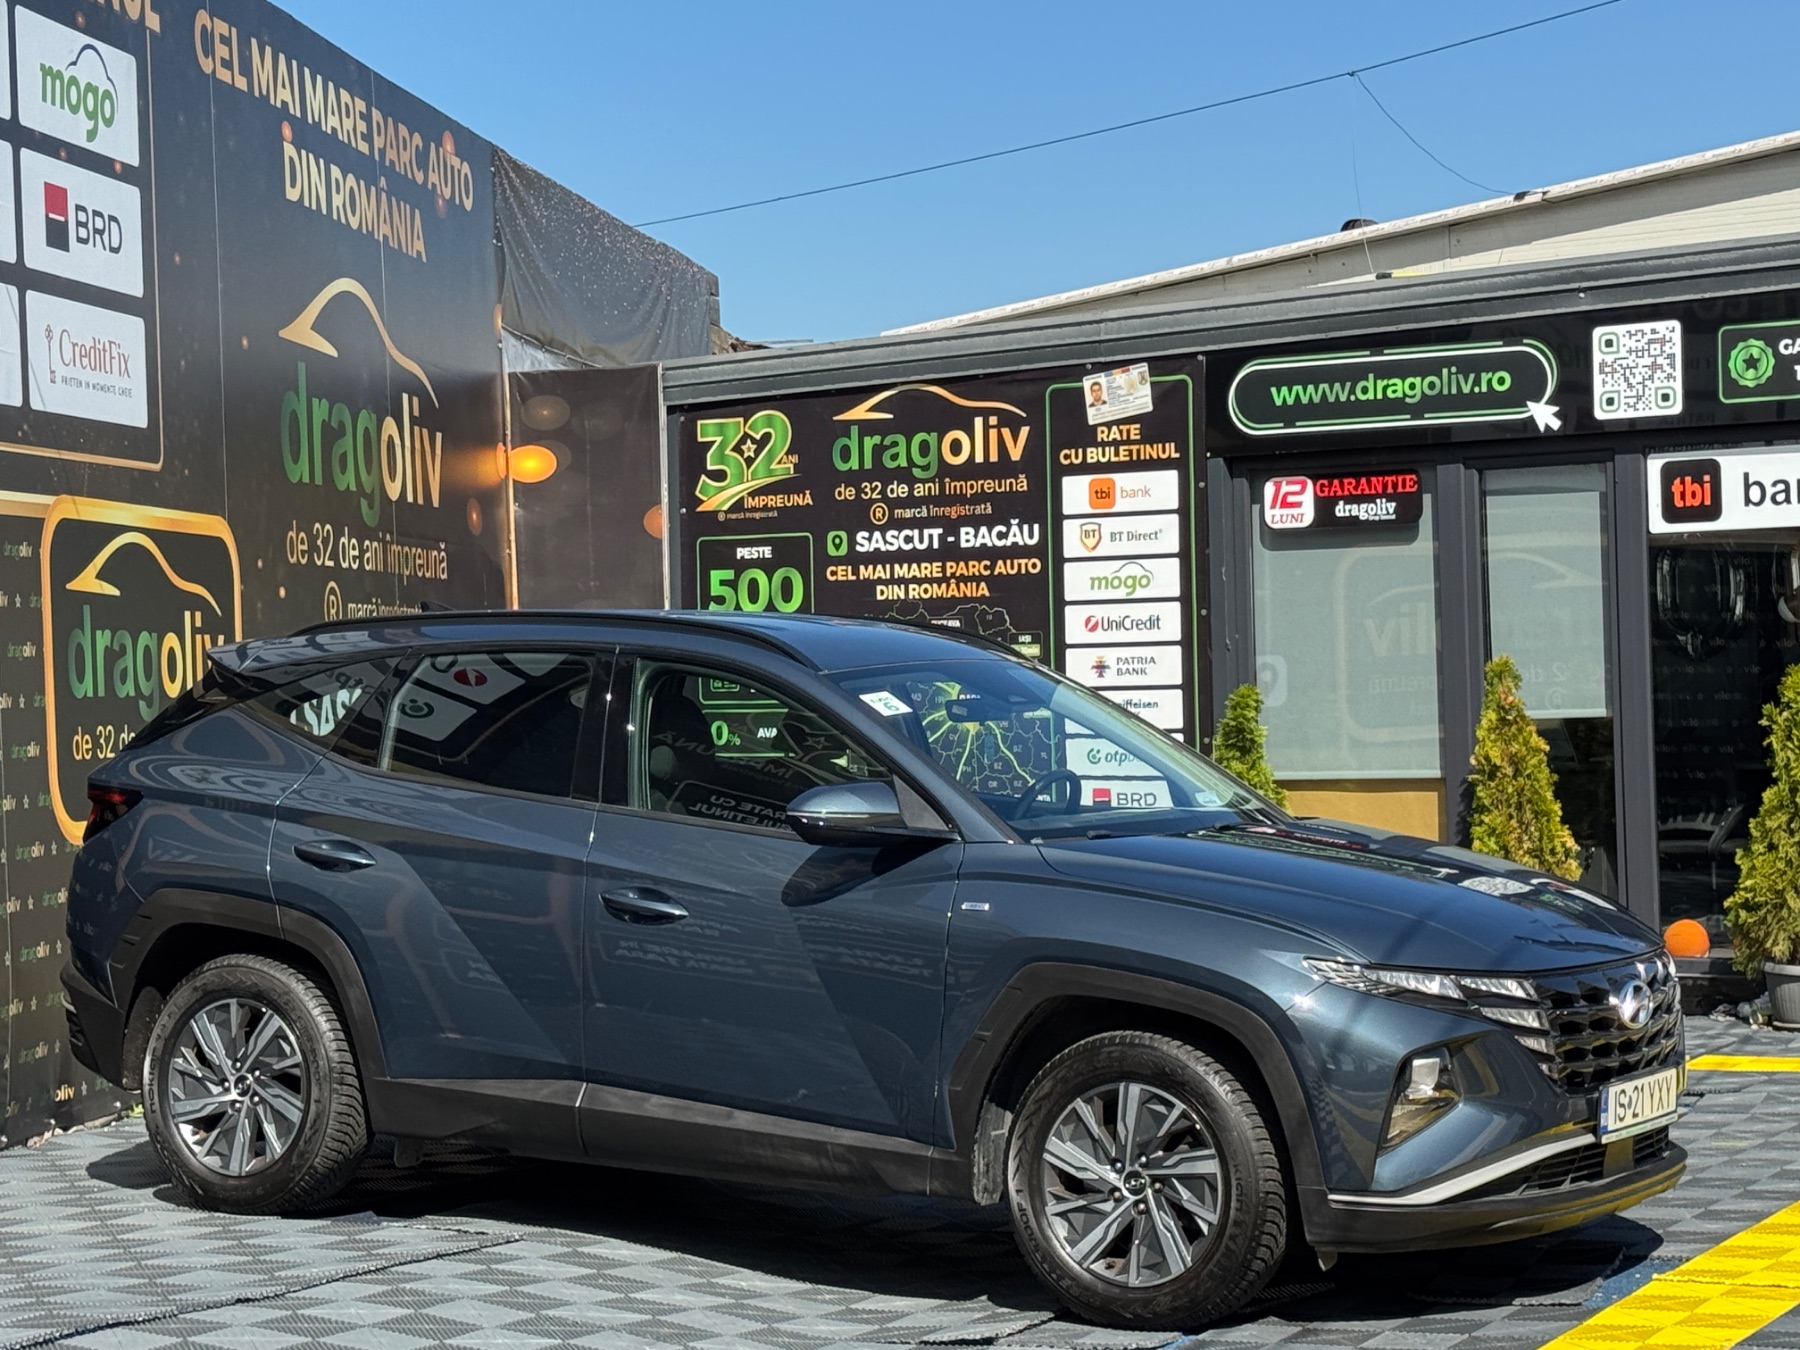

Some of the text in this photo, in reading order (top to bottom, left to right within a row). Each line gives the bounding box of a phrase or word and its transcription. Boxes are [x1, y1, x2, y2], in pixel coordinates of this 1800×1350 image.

[39, 62, 116, 143] mogo
[194, 9, 248, 92] CEL
[250, 37, 301, 118] MAI
[304, 65, 369, 155] MARE
[371, 106, 424, 185] PARC
[427, 141, 473, 211] AUTO
[283, 140, 427, 263] DIN ROMÂNIA
[74, 203, 123, 254] BRD
[59, 329, 131, 379] CreditFix
[1270, 366, 1511, 407] www.dragoliv.ro
[281, 361, 443, 527] dragoliv
[1097, 424, 1141, 442] RATE
[695, 409, 793, 502] 32
[781, 454, 799, 465] ANI
[832, 416, 1031, 479] dragoliv
[1059, 442, 1180, 465] CU BULETINUL
[835, 473, 1028, 500] de 32 de ani împreună
[1094, 485, 1152, 500] tbi bank
[1270, 473, 1419, 509] 12 GARANTIE
[1671, 471, 1800, 508] tbi ba
[744, 490, 813, 509] ÎMPREUNĂ
[894, 504, 928, 520] marcă
[929, 502, 992, 520] înregistrată
[1335, 497, 1397, 520] dragoliv
[1270, 512, 1305, 525] LUNI
[855, 528, 944, 551] SASCUT
[959, 519, 1040, 548] BACĂU
[1110, 532, 1124, 543] BT
[287, 519, 448, 586] de 32 de ani împreună
[736, 546, 773, 559] PESTE
[826, 558, 1042, 581] CEL MAI MARE PARC AUTO
[708, 567, 804, 614] 500
[876, 580, 990, 601] DIN ROMÂNIA
[1089, 573, 1151, 597] mogo
[1101, 614, 1161, 632] UniCredit
[1116, 656, 1157, 665] PATRIA
[1116, 667, 1148, 676] BANK
[73, 726, 92, 760] de
[97, 725, 115, 759] 32
[1116, 792, 1157, 807] BRD
